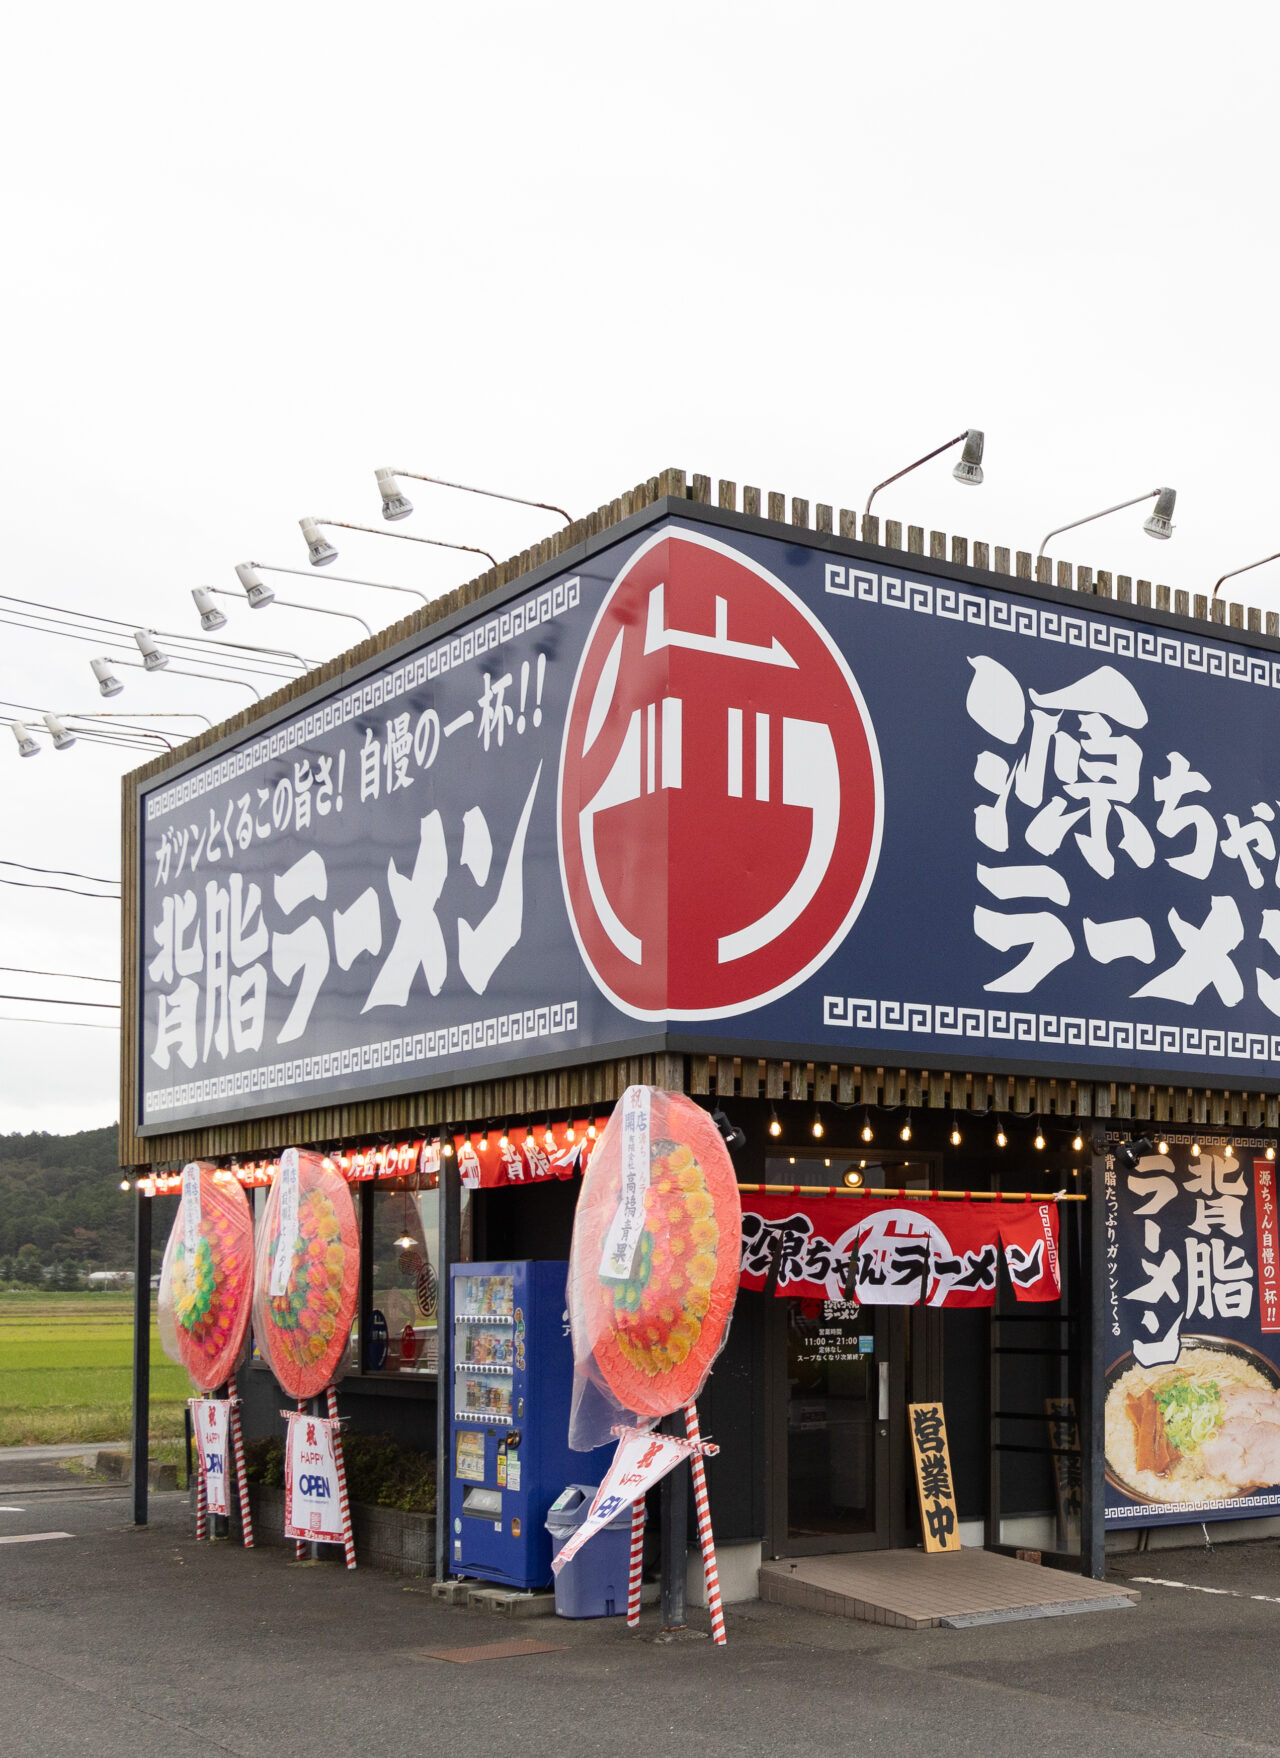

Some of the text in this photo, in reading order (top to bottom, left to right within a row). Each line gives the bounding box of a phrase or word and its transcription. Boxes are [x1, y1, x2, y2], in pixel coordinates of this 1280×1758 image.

[148, 758, 543, 1071] 背脂ラーメン
[630, 1088, 642, 1110] 祝
[624, 1111, 648, 1133] 開店
[1182, 1153, 1254, 1320] 背脂
[1122, 1154, 1185, 1369] ラーメン
[823, 1309, 860, 1321] ラーメン
[804, 1337, 826, 1346] 11:00
[836, 1337, 858, 1345] 21:00
[818, 1328, 843, 1336] 営業時間
[818, 1346, 842, 1354] 定休なし
[300, 1452, 325, 1466] HAPPY
[299, 1473, 331, 1499] OPEN
[913, 1407, 955, 1548] 営業中
